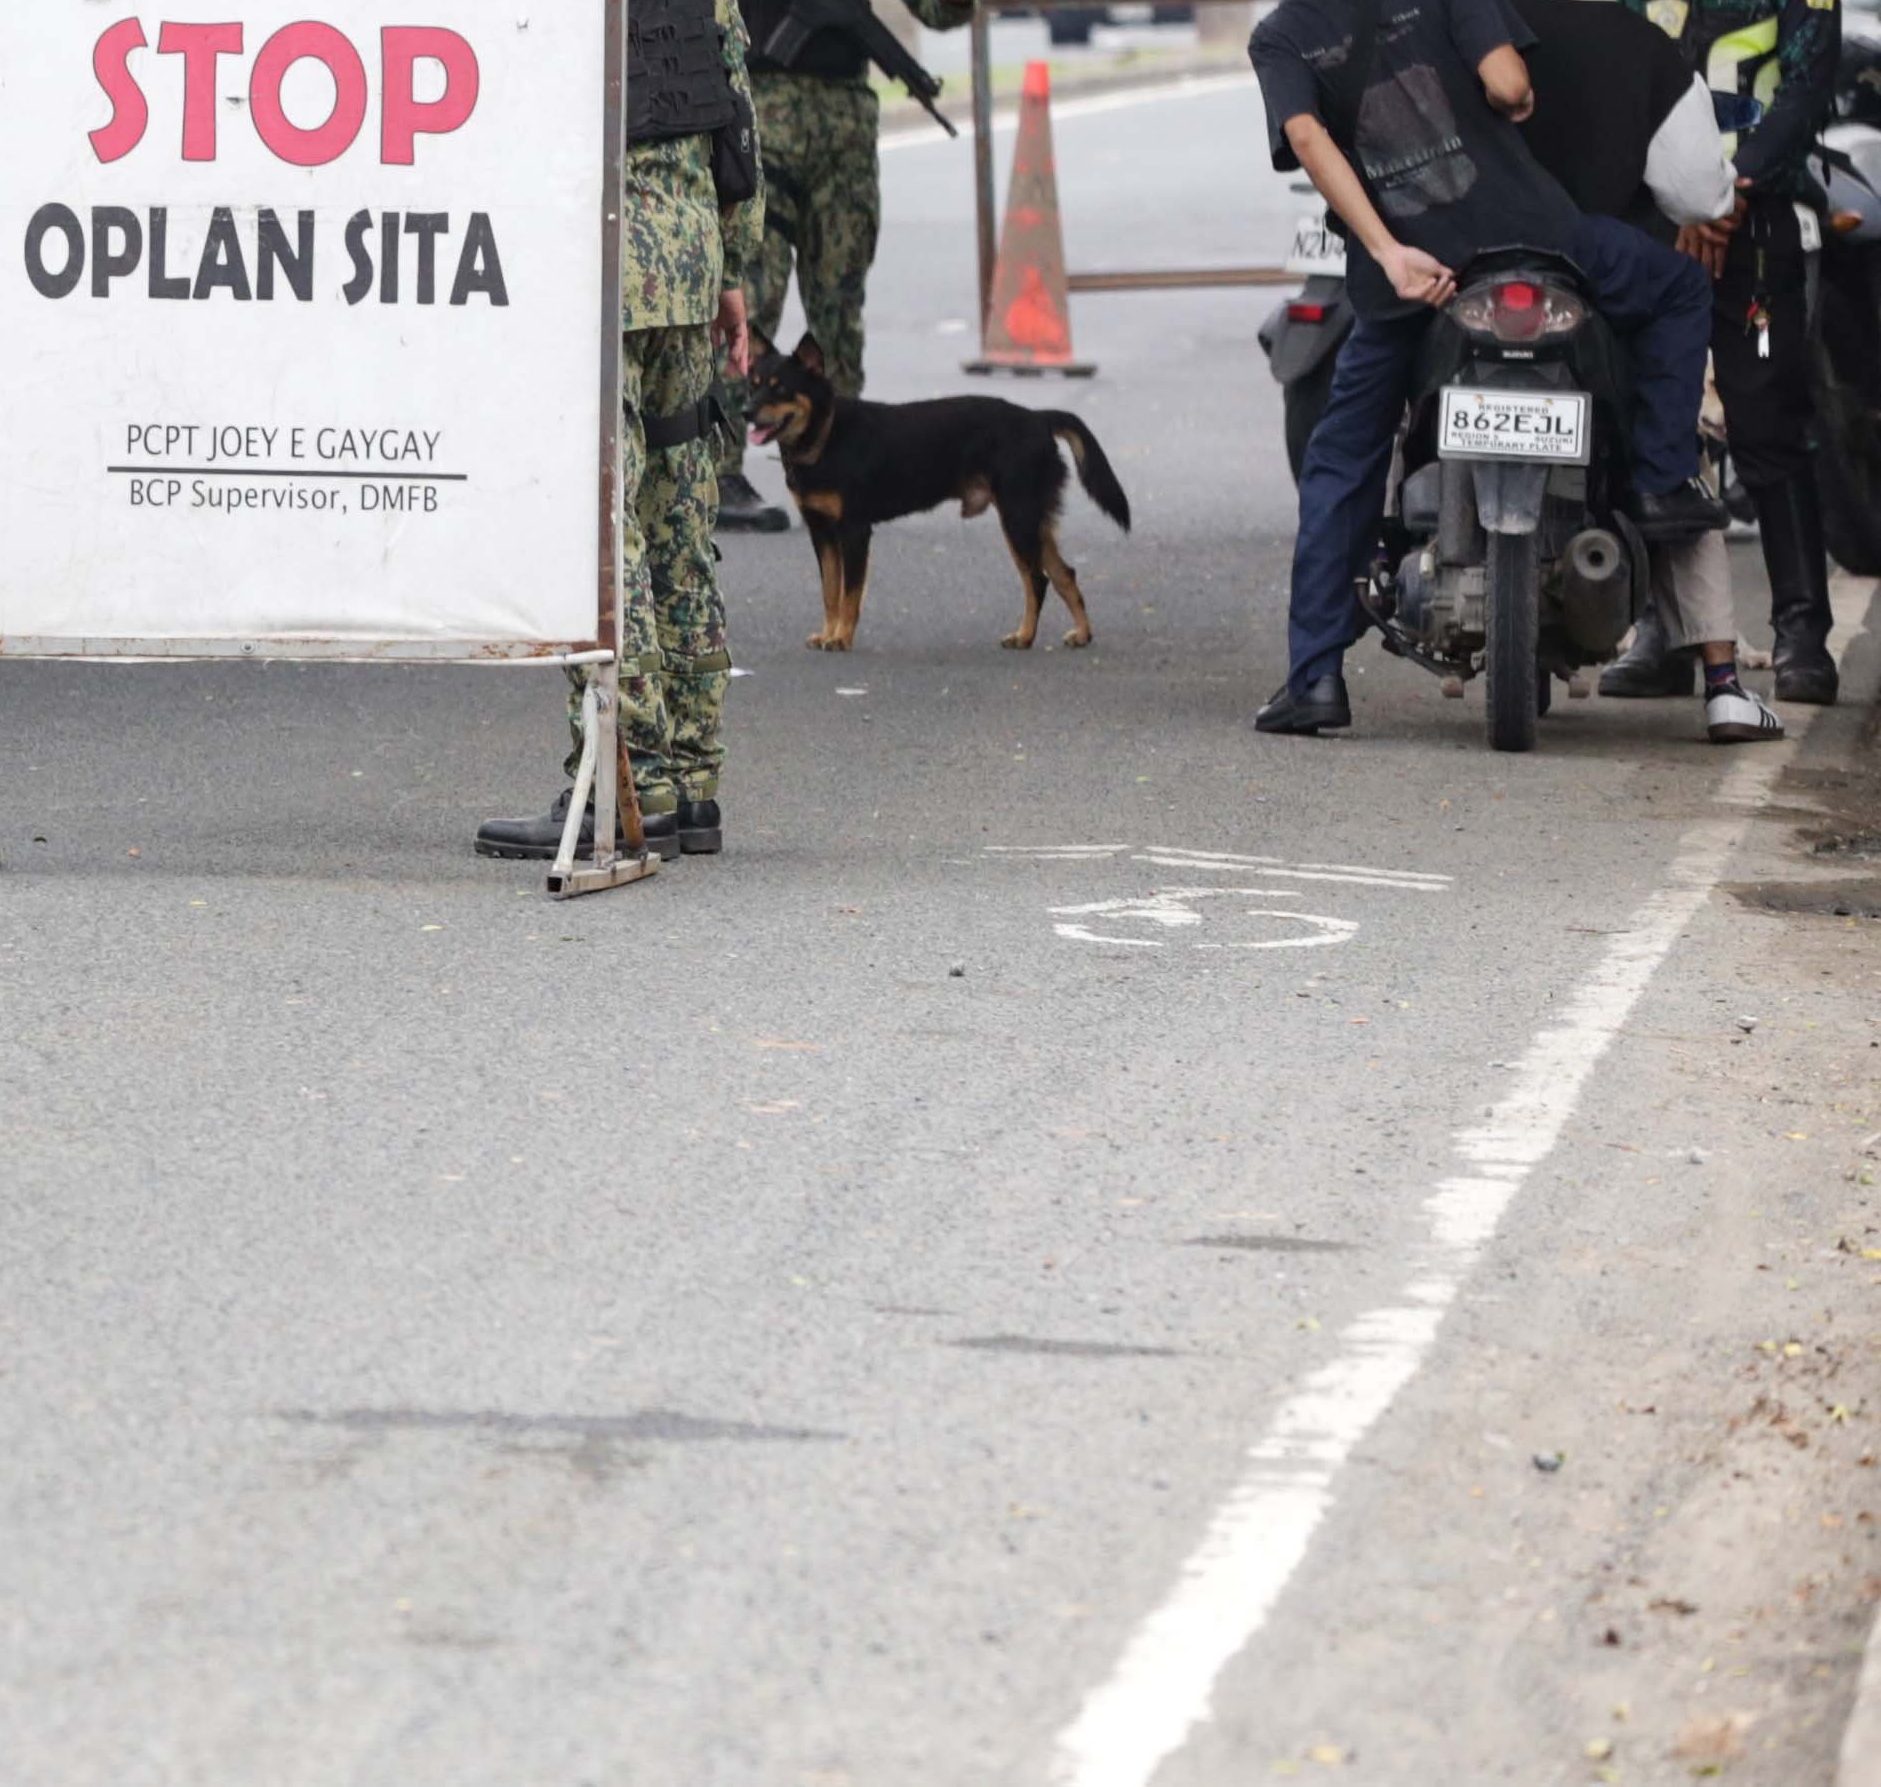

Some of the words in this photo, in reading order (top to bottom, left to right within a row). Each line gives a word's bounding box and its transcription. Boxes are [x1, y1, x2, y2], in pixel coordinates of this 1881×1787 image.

[88, 16, 480, 168] STOP
[24, 202, 315, 302] OPLAN
[342, 207, 510, 307] SITA
[1453, 410, 1574, 436] 862EJL
[1478, 403, 1549, 415] REGISTERED
[127, 424, 200, 457] PCPT
[206, 425, 278, 462] JOEY
[290, 427, 305, 458] E
[316, 427, 441, 462] GAYGAY
[1461, 438, 1526, 451] TEMPORARY
[1529, 442, 1561, 453] PLATE
[130, 478, 182, 507] BCP
[191, 479, 348, 515] Supervisor,
[360, 483, 438, 513] DMFB
